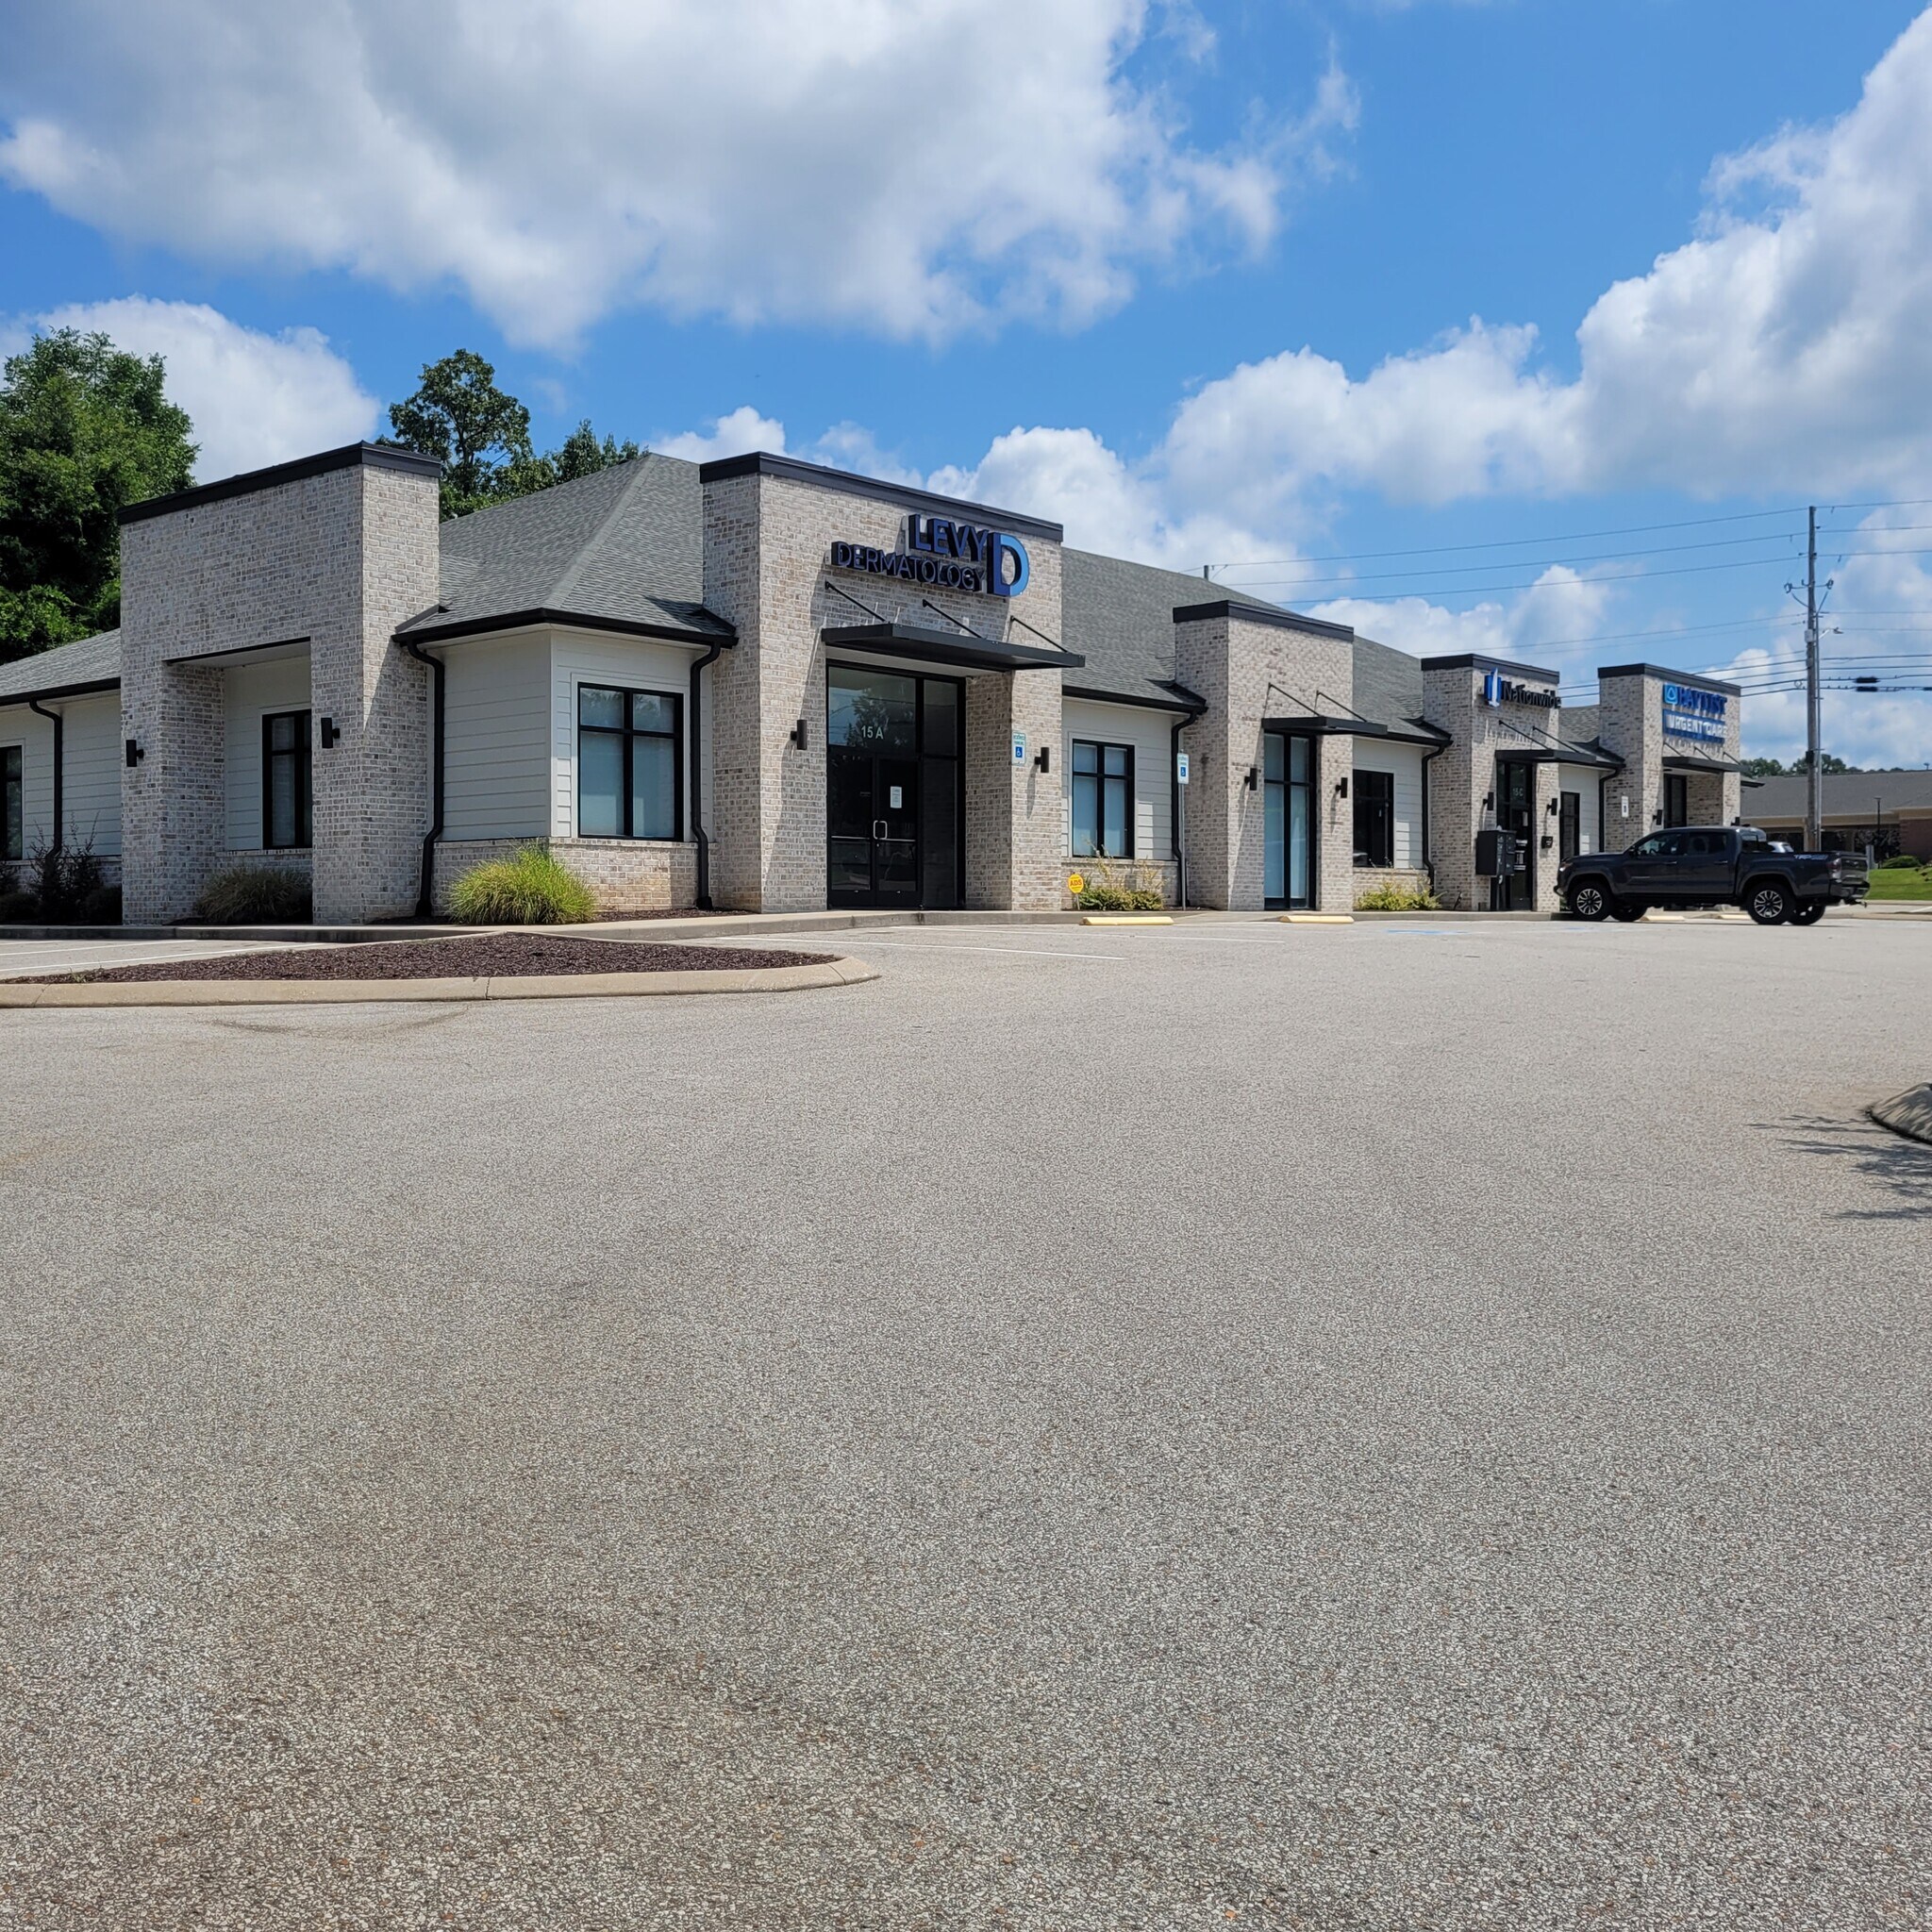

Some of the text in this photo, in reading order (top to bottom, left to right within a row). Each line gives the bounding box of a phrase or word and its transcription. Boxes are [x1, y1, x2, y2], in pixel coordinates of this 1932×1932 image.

[908, 514, 988, 561] LEVY
[832, 541, 986, 591] DERMATOLOGY
[1502, 680, 1561, 708] Nationwide
[860, 724, 874, 738] 15
[1666, 714, 1728, 739] URGENT CARE
